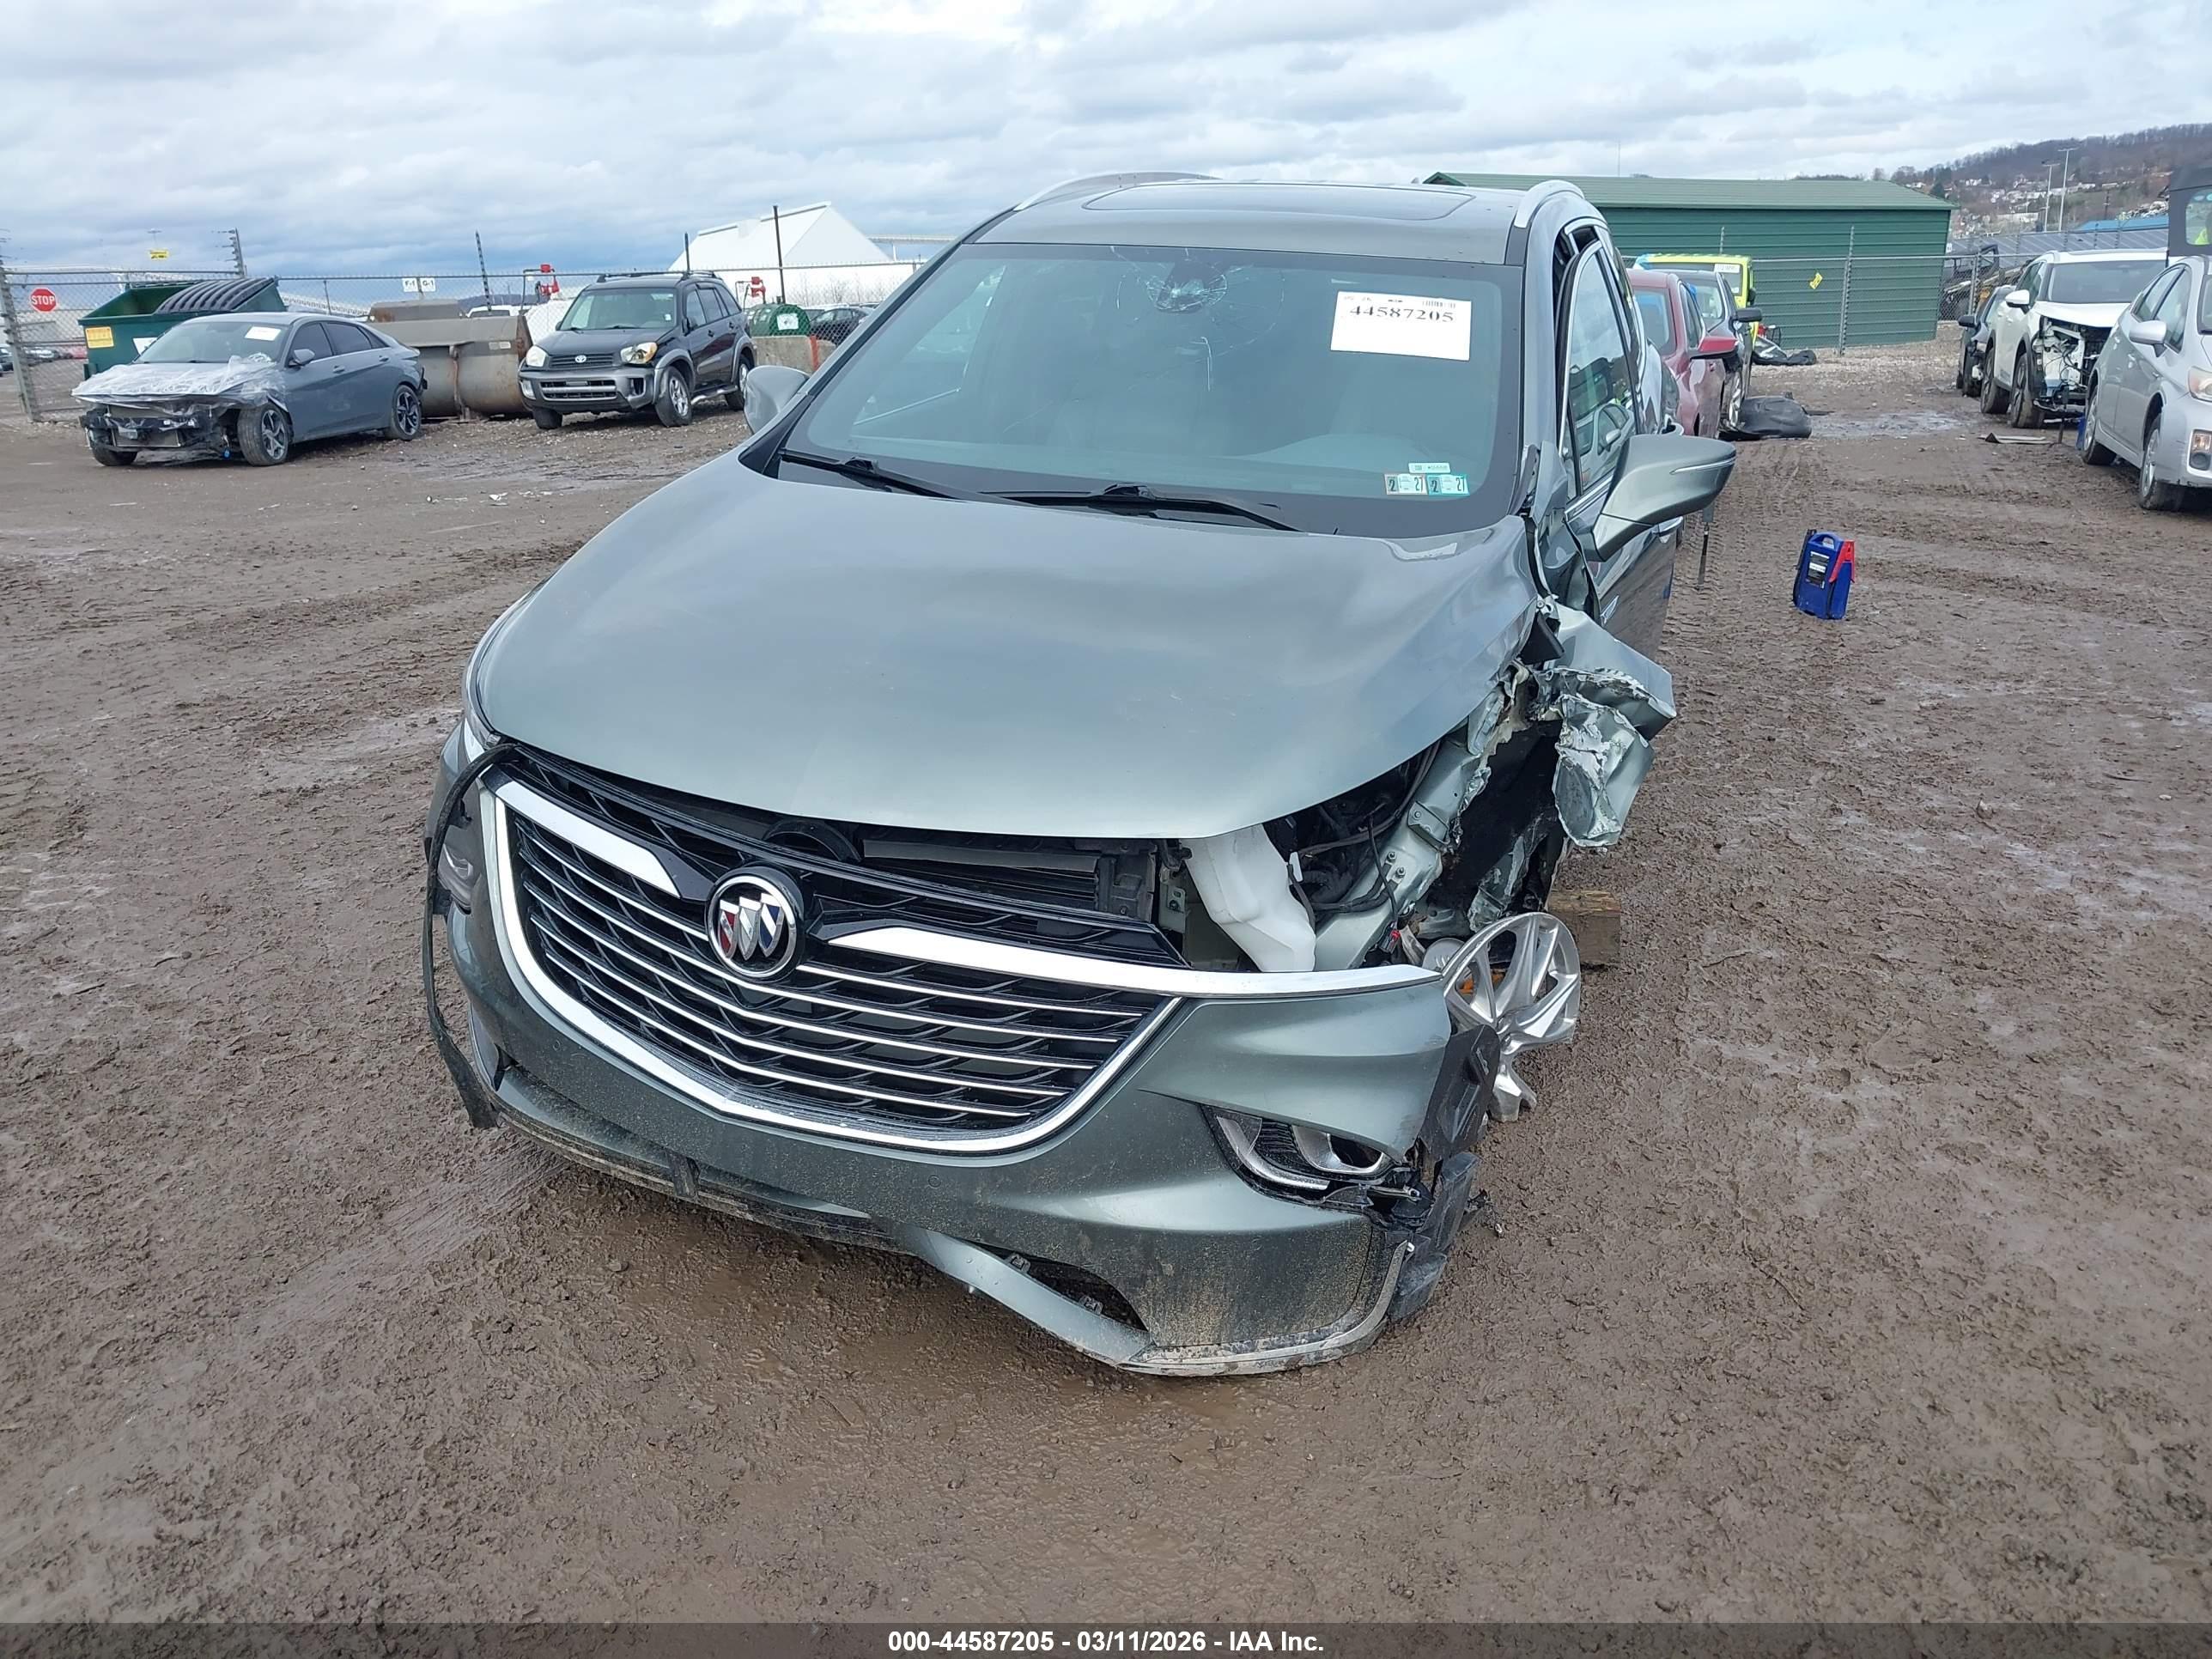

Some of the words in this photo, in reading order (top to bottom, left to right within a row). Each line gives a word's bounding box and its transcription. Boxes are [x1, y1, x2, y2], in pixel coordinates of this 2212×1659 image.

[31, 295, 55, 306] STOP
[1349, 305, 1455, 323] 44587205
[1414, 477, 1424, 493] 27
[1455, 477, 1465, 493] 27
